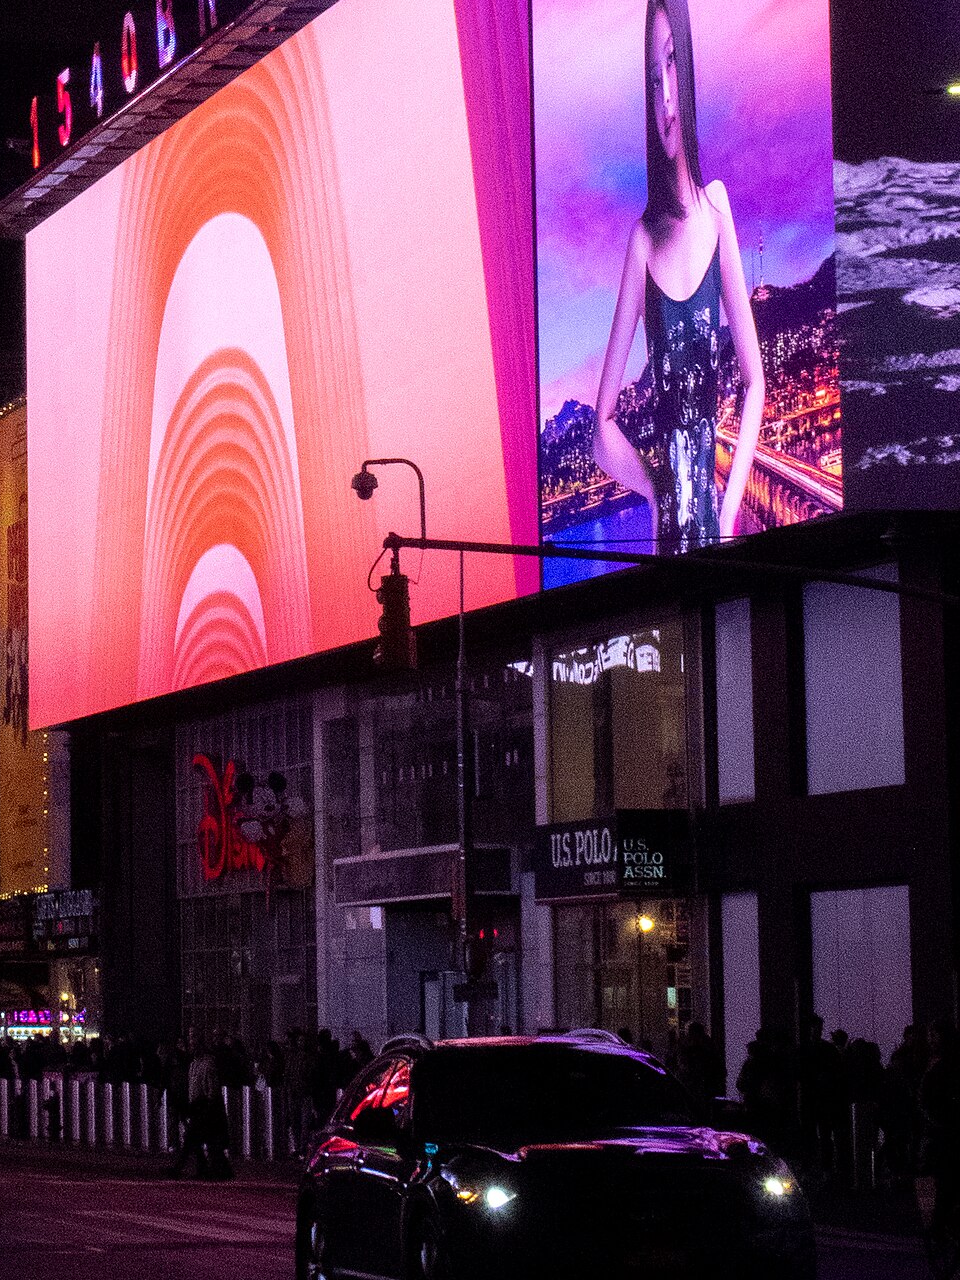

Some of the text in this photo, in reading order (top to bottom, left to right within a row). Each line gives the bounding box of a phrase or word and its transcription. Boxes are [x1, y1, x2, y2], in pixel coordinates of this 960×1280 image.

[30, 11, 137, 169] 1540
[574, 827, 612, 866] POLO
[623, 851, 664, 865] POLO
[623, 865, 667, 879] ASSN.
